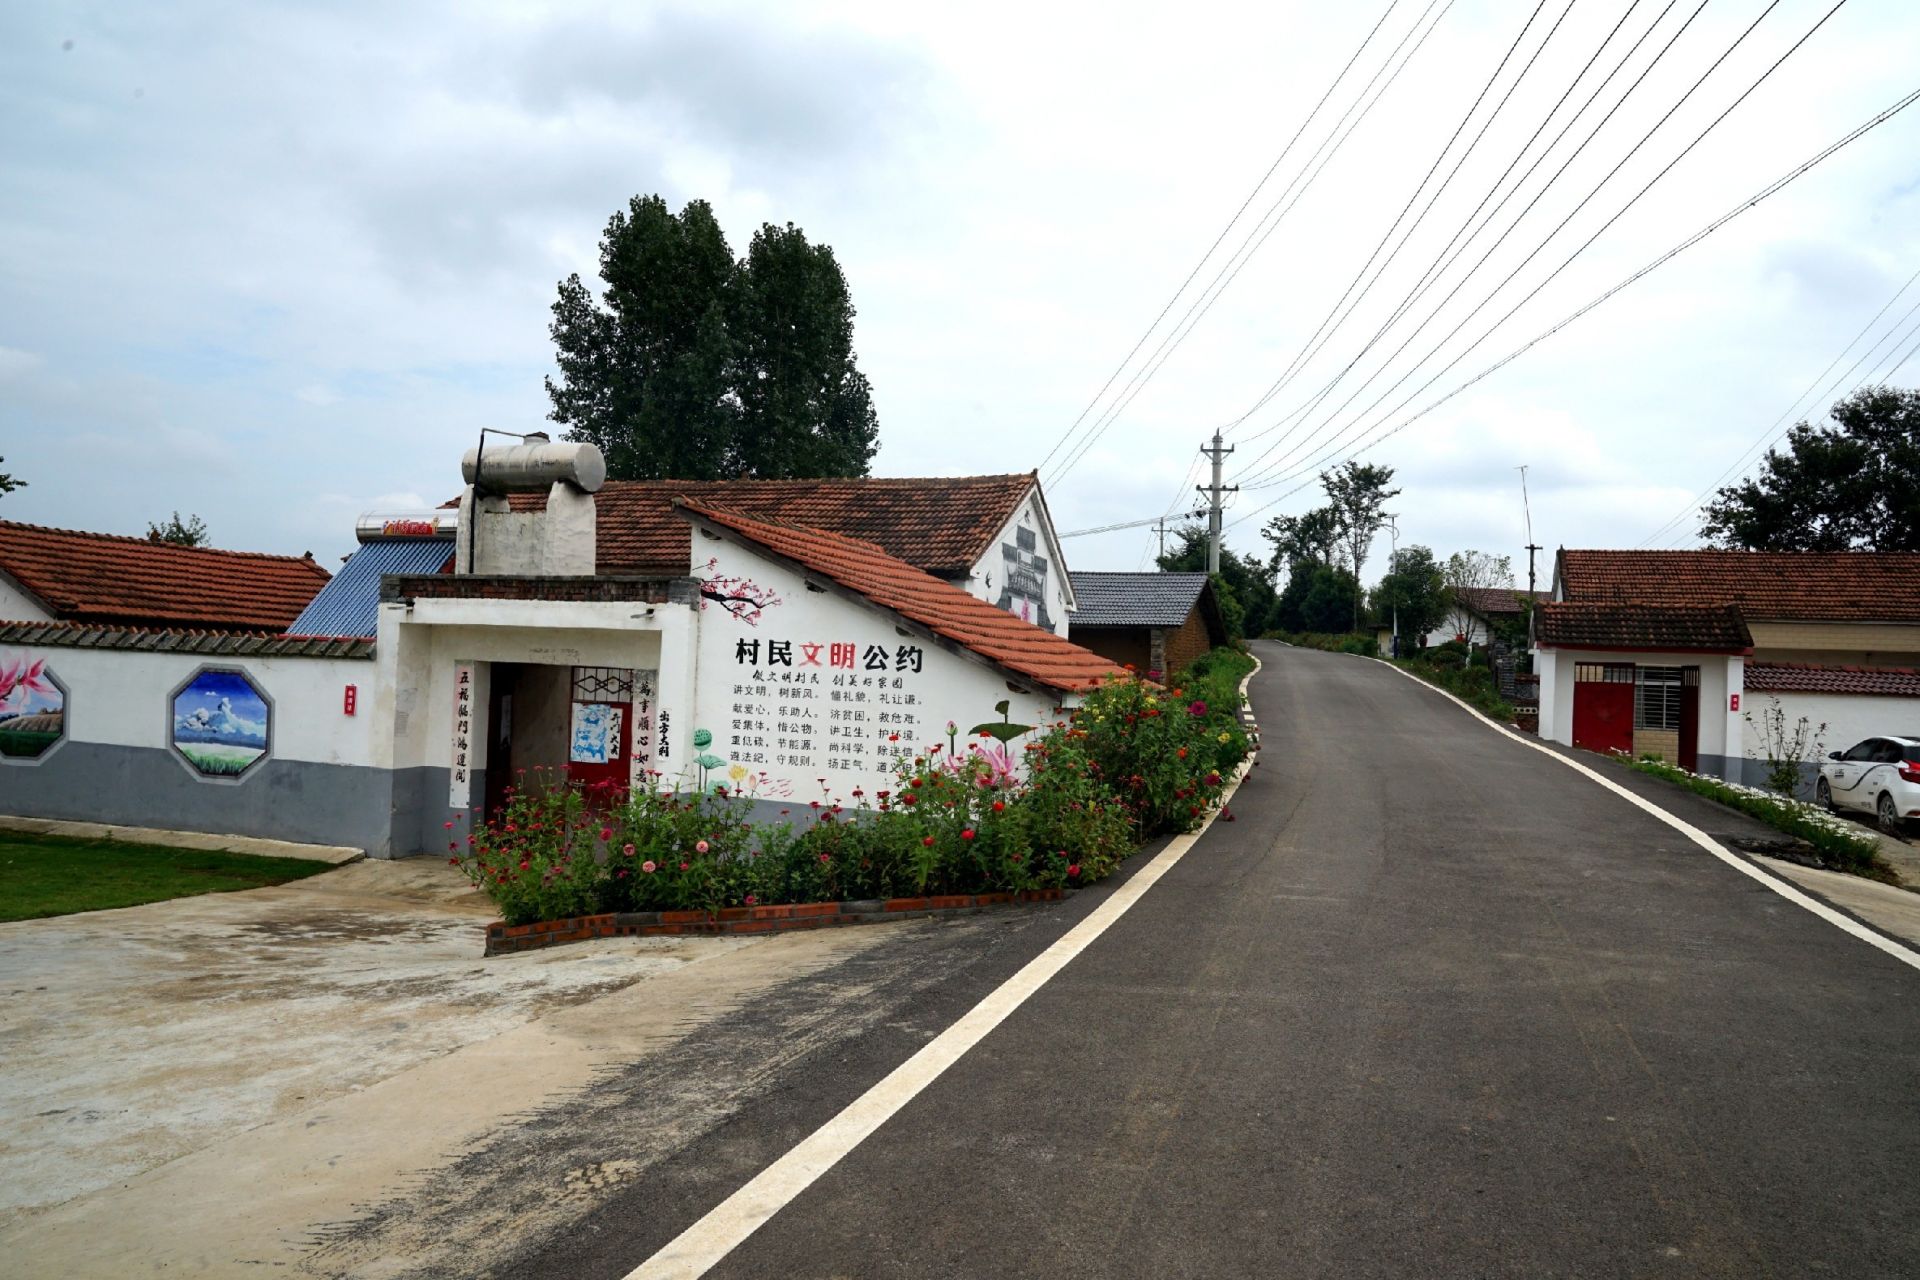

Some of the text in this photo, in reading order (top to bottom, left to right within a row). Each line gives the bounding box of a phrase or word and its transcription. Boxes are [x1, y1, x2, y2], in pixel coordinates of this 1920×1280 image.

[735, 638, 923, 673] 村民文明公约
[752, 669, 819, 684] 做文明村民
